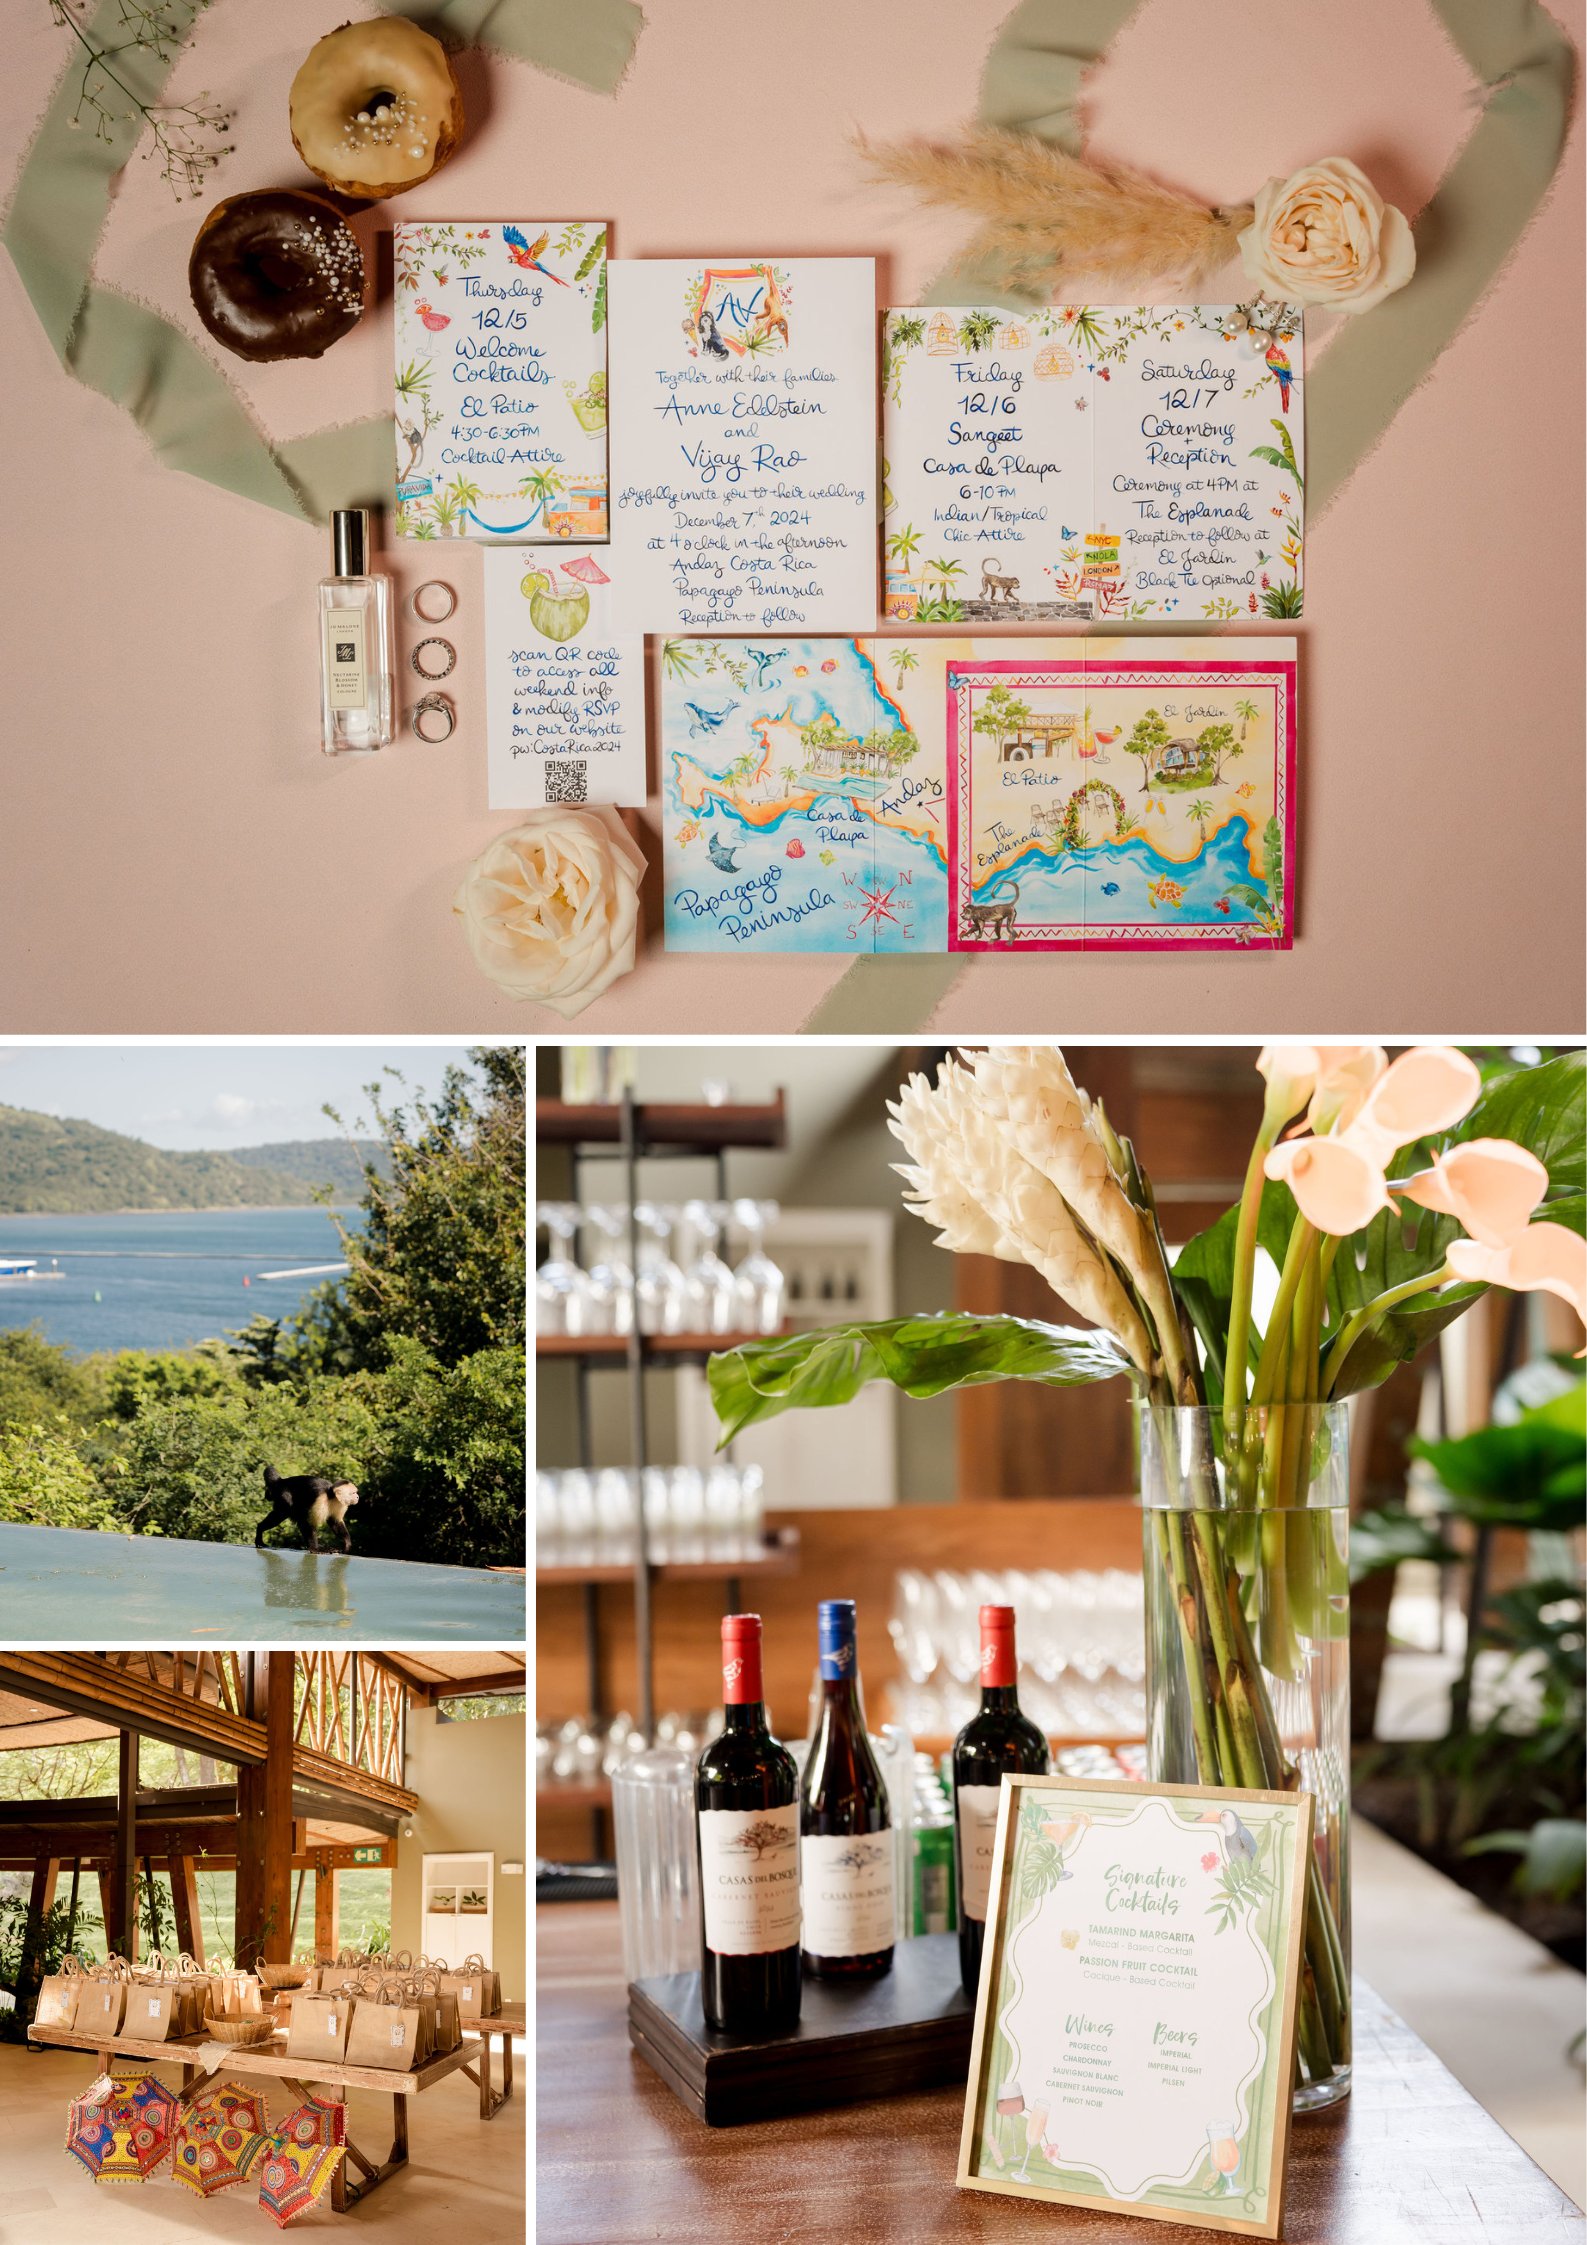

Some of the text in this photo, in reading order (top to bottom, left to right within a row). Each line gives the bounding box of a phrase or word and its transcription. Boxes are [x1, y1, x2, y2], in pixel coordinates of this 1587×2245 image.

[456, 276, 544, 307] Thursday
[472, 307, 527, 330] 12/5
[456, 336, 547, 358] Welcome
[453, 361, 556, 384] Cocktails
[656, 368, 839, 389] Together with their families
[951, 362, 1024, 391] Friday
[1141, 360, 1238, 391] Saturday
[461, 394, 539, 417] El Patio
[654, 392, 827, 425] Anne Edelstein
[958, 395, 1017, 415] 12/6
[1160, 389, 1218, 410] 12/7
[724, 422, 760, 438] and
[948, 422, 1023, 453] Sangeet
[1141, 415, 1235, 444] Ceremony
[442, 448, 565, 464] Cocktail Attire
[681, 441, 807, 482] Vijay Rao
[1146, 442, 1236, 470] Reception
[924, 456, 1061, 482] Casa de Playa
[618, 483, 866, 509] joyfully invite you to their wedding
[1112, 477, 1260, 498] Ceremony at 4PM at
[674, 513, 741, 529] December
[770, 511, 812, 526] 2024
[934, 506, 1048, 524] Indian/Tropical
[1132, 501, 1254, 524] The Esplanade
[647, 537, 665, 550] at
[670, 534, 680, 549] 4
[734, 538, 750, 550] in
[750, 535, 775, 550] the
[777, 534, 847, 555] afternoon
[944, 527, 1025, 542] Chic Attire
[1094, 536, 1111, 544] NYC
[1126, 528, 1271, 548] Reception to follow at
[1094, 551, 1115, 559] NOLA
[1159, 549, 1237, 568] El Jardin
[669, 555, 817, 578] Andaz Costa Rica
[1083, 567, 1112, 575] LONDON
[1136, 571, 1256, 590] Black Tie Optional
[673, 577, 824, 607] Papagayo Peninsula
[679, 608, 806, 627] Reception to follow
[507, 647, 623, 663] scan QR code
[513, 662, 620, 678] to access all
[514, 679, 613, 701] weekend info
[512, 699, 620, 724] & modify RSVP
[1164, 704, 1229, 722] El Jardin
[512, 720, 626, 736] on our website
[1002, 768, 1061, 788] El Patio
[876, 775, 943, 818] Andaz
[807, 808, 866, 823] Casa de
[816, 826, 869, 848] Playa
[985, 821, 1016, 840] The
[977, 826, 1045, 868] Esplanade
[842, 872, 857, 886] W
[898, 870, 912, 886] N
[674, 864, 783, 919] Papagayo
[843, 900, 913, 909] SW NE
[718, 888, 836, 944] Peninsula
[846, 924, 857, 939] S
[903, 923, 914, 938] E
[719, 1875, 753, 1885] CASAS
[1104, 1864, 1187, 1890] Signature
[1106, 1888, 1181, 1915] Cocktails
[1089, 1924, 1195, 1943] TAMARIND MARGARITA
[1088, 1938, 1193, 1956] Mezcal Based Cocktail
[1079, 1956, 1198, 1977] PASSION FRUIT COCKTAIL
[1129, 1975, 1156, 1986] Based
[1159, 1978, 1195, 1990] Cocktail
[1065, 2013, 1114, 2037] Wines
[1153, 2021, 1199, 2046] Beers
[1069, 2041, 1108, 2052] PROSECCO
[1160, 2049, 1192, 2059] IMPERIAL
[1062, 2054, 1112, 2067] CHARDONNAY
[1148, 2062, 1202, 2075] IMPERIAL LIGHT
[1052, 2067, 1119, 2082] SAUVIGNON BLANC
[1162, 2078, 1185, 2087] PILSEN
[1045, 2080, 1124, 2097] CABERNET SAUVIGNON
[1062, 2096, 1103, 2108] PINOT NOIR
